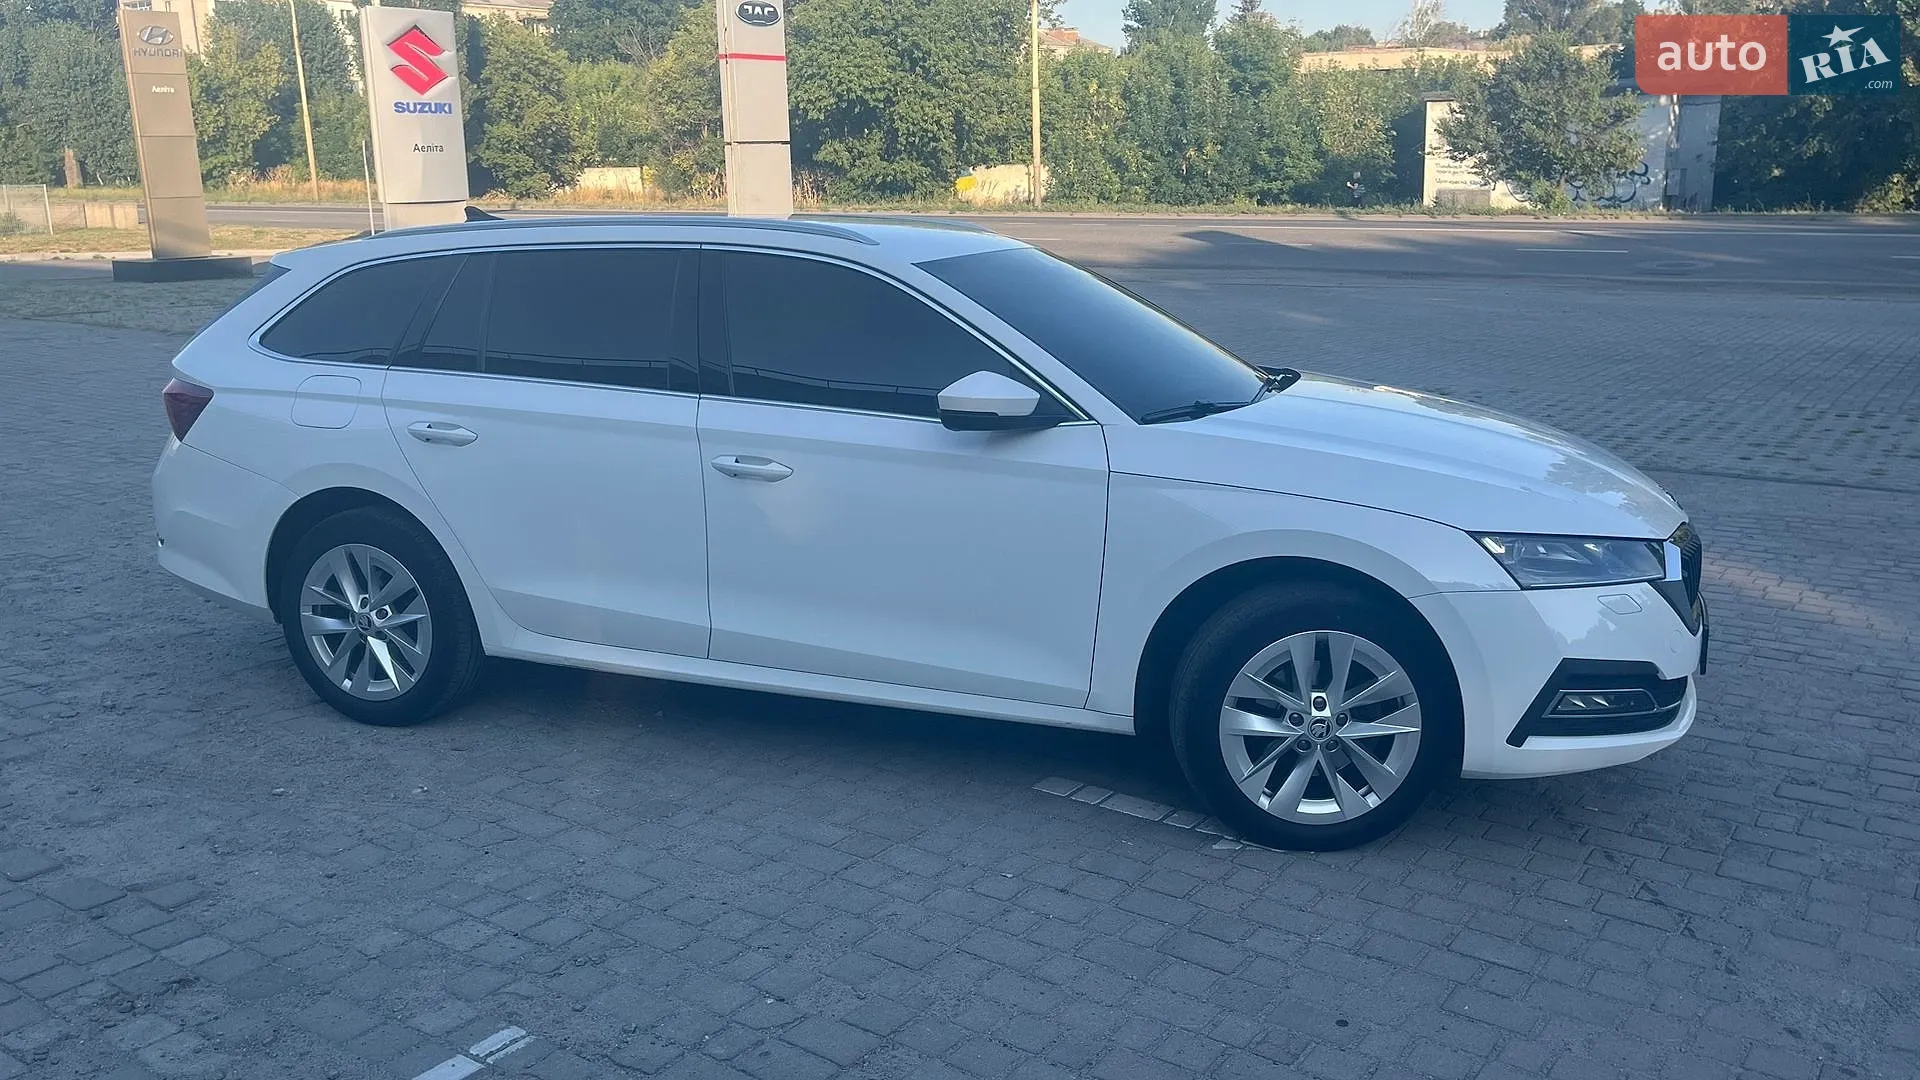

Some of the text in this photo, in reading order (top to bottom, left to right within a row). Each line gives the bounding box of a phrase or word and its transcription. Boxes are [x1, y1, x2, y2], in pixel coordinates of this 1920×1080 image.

[133, 47, 183, 58] HYUNDAI
[393, 101, 453, 115] SUZUKI
[413, 143, 445, 153] Аеліта
